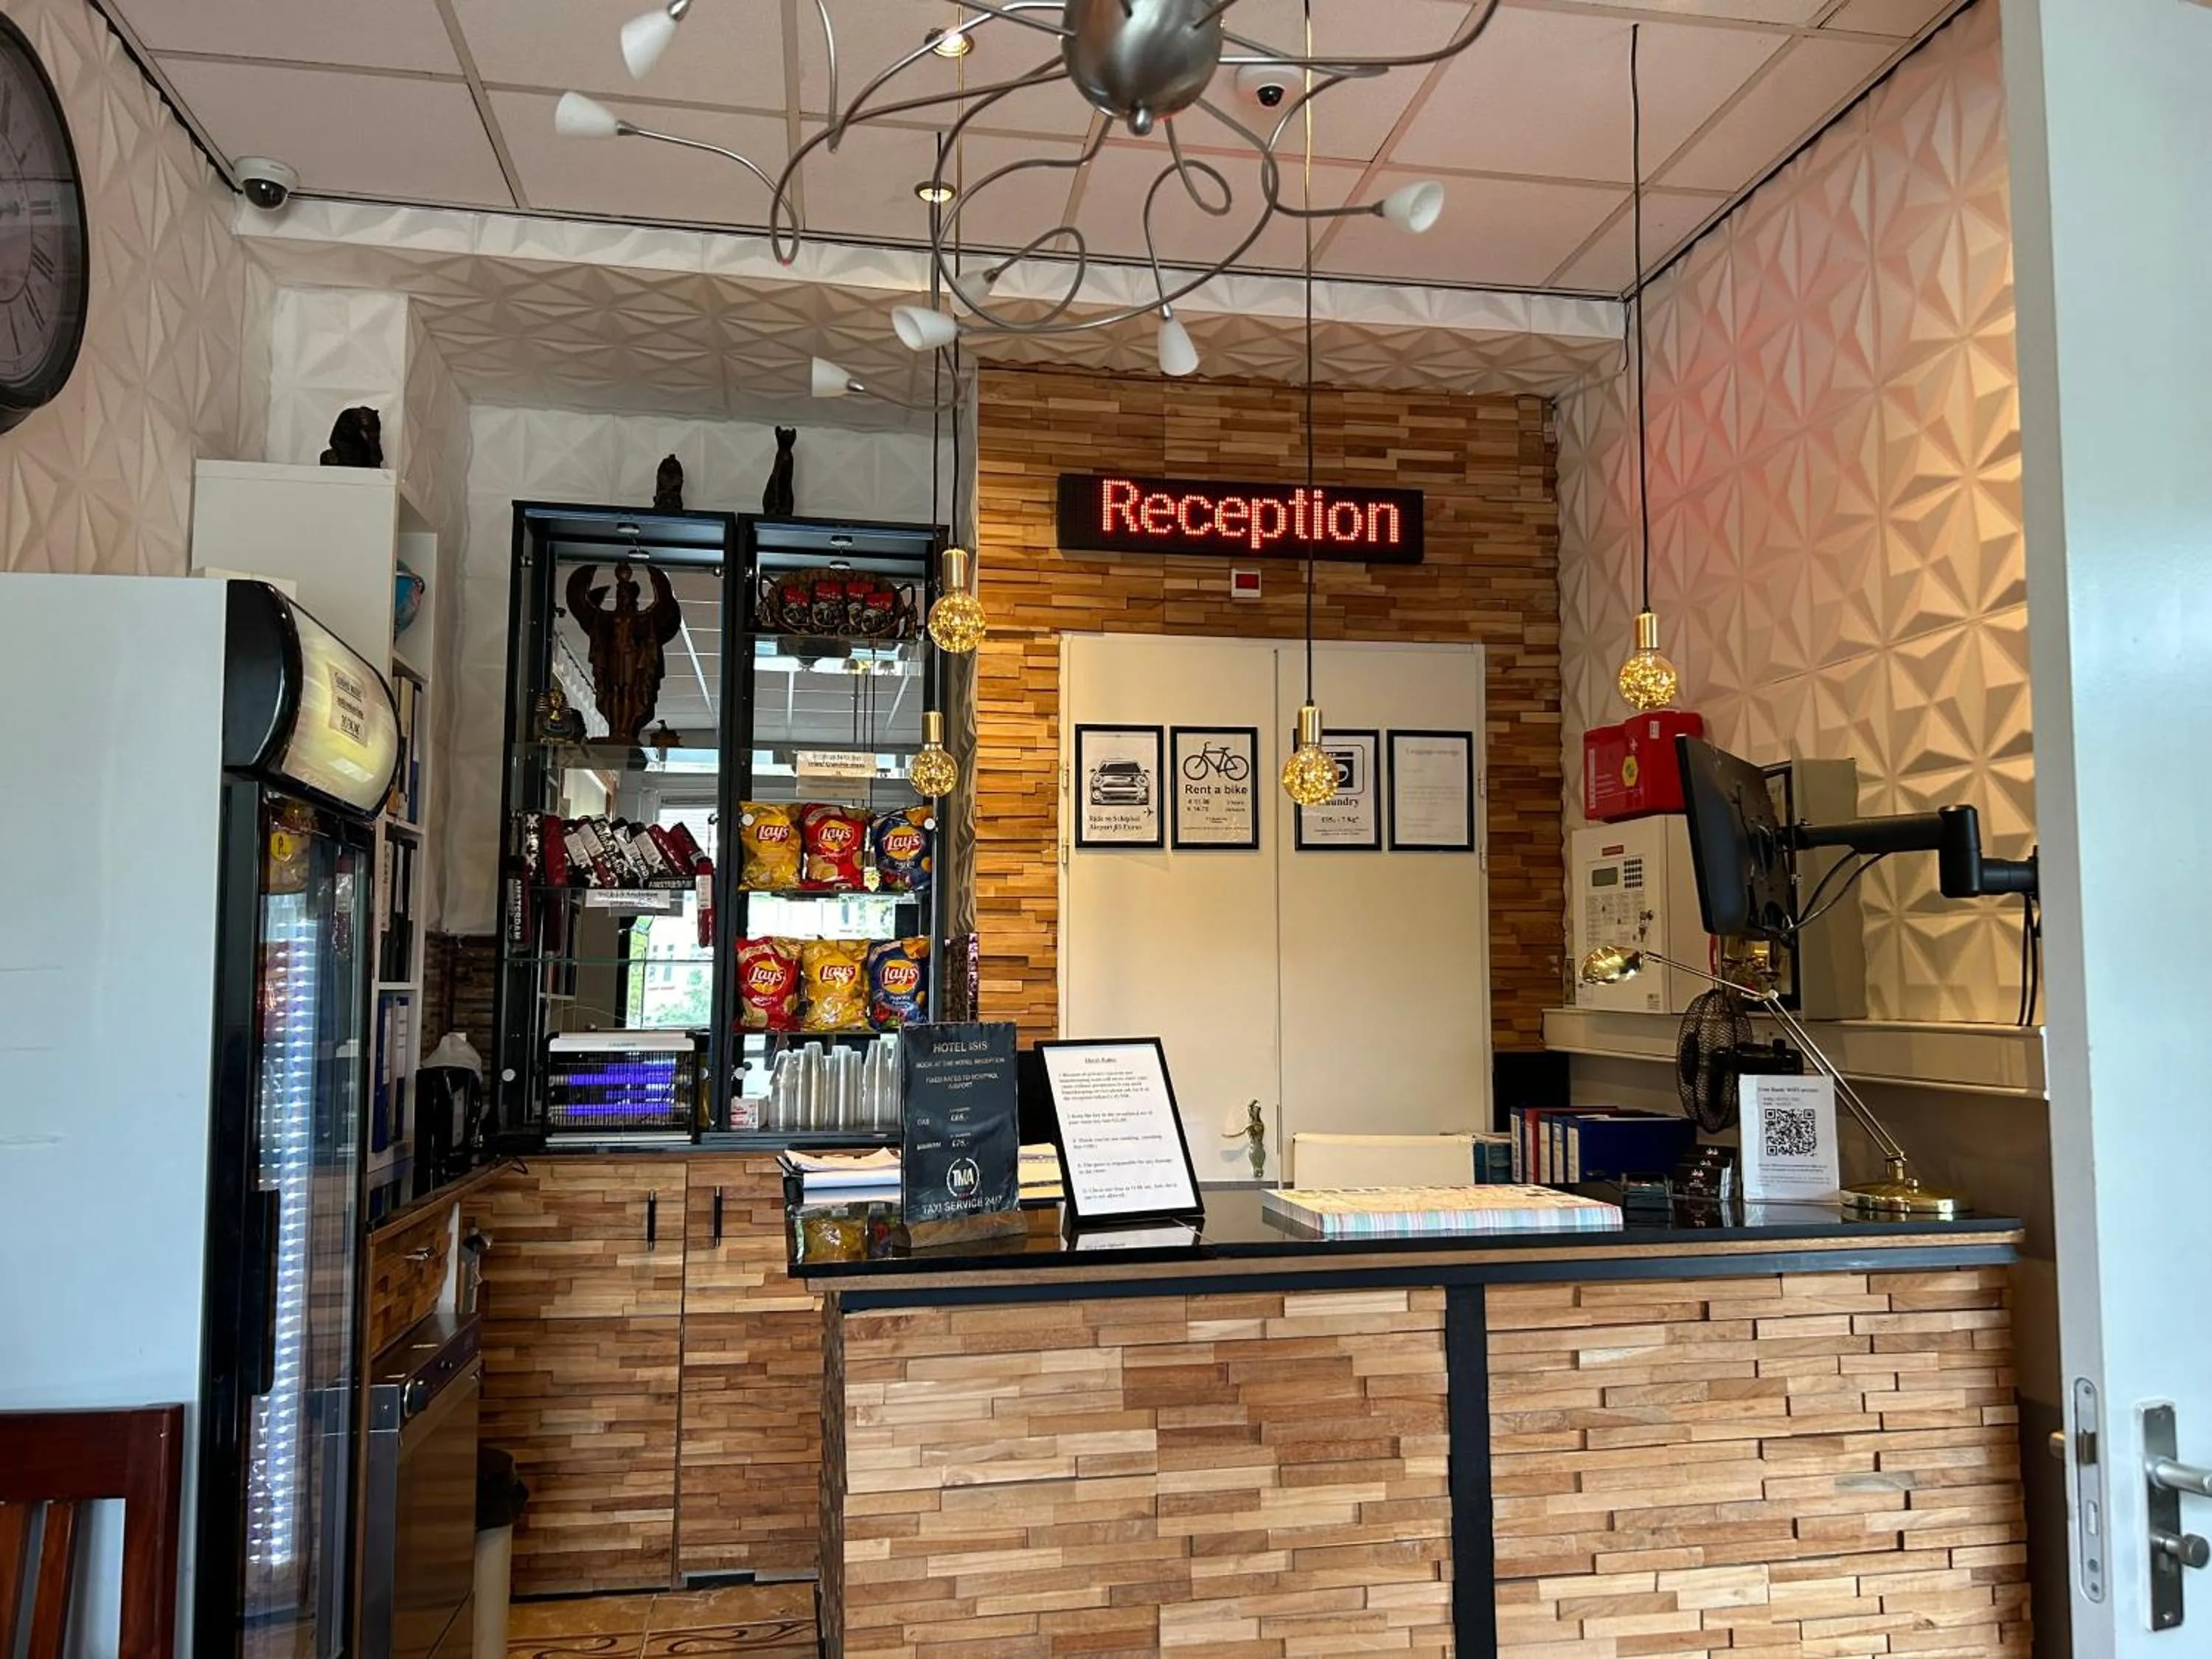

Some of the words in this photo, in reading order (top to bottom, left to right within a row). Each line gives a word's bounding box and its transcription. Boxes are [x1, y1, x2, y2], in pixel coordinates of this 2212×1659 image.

[1102, 479, 1399, 550] Reception
[1185, 784, 1211, 794] Rent
[1224, 785, 1248, 794] bike
[758, 824, 790, 841] Lay's
[821, 825, 852, 842] Lay's
[886, 833, 920, 852] Lay's
[751, 965, 785, 985] Lay's
[822, 964, 855, 982] Lay's
[883, 966, 919, 987] Lay's
[933, 1041, 967, 1054] HOTEL
[968, 1040, 988, 1051] ISIS
[952, 1167, 975, 1186] TMA
[922, 1203, 942, 1214] TAXI
[944, 1199, 983, 1212] SERVICE
[984, 1194, 1003, 1206] 24/7
